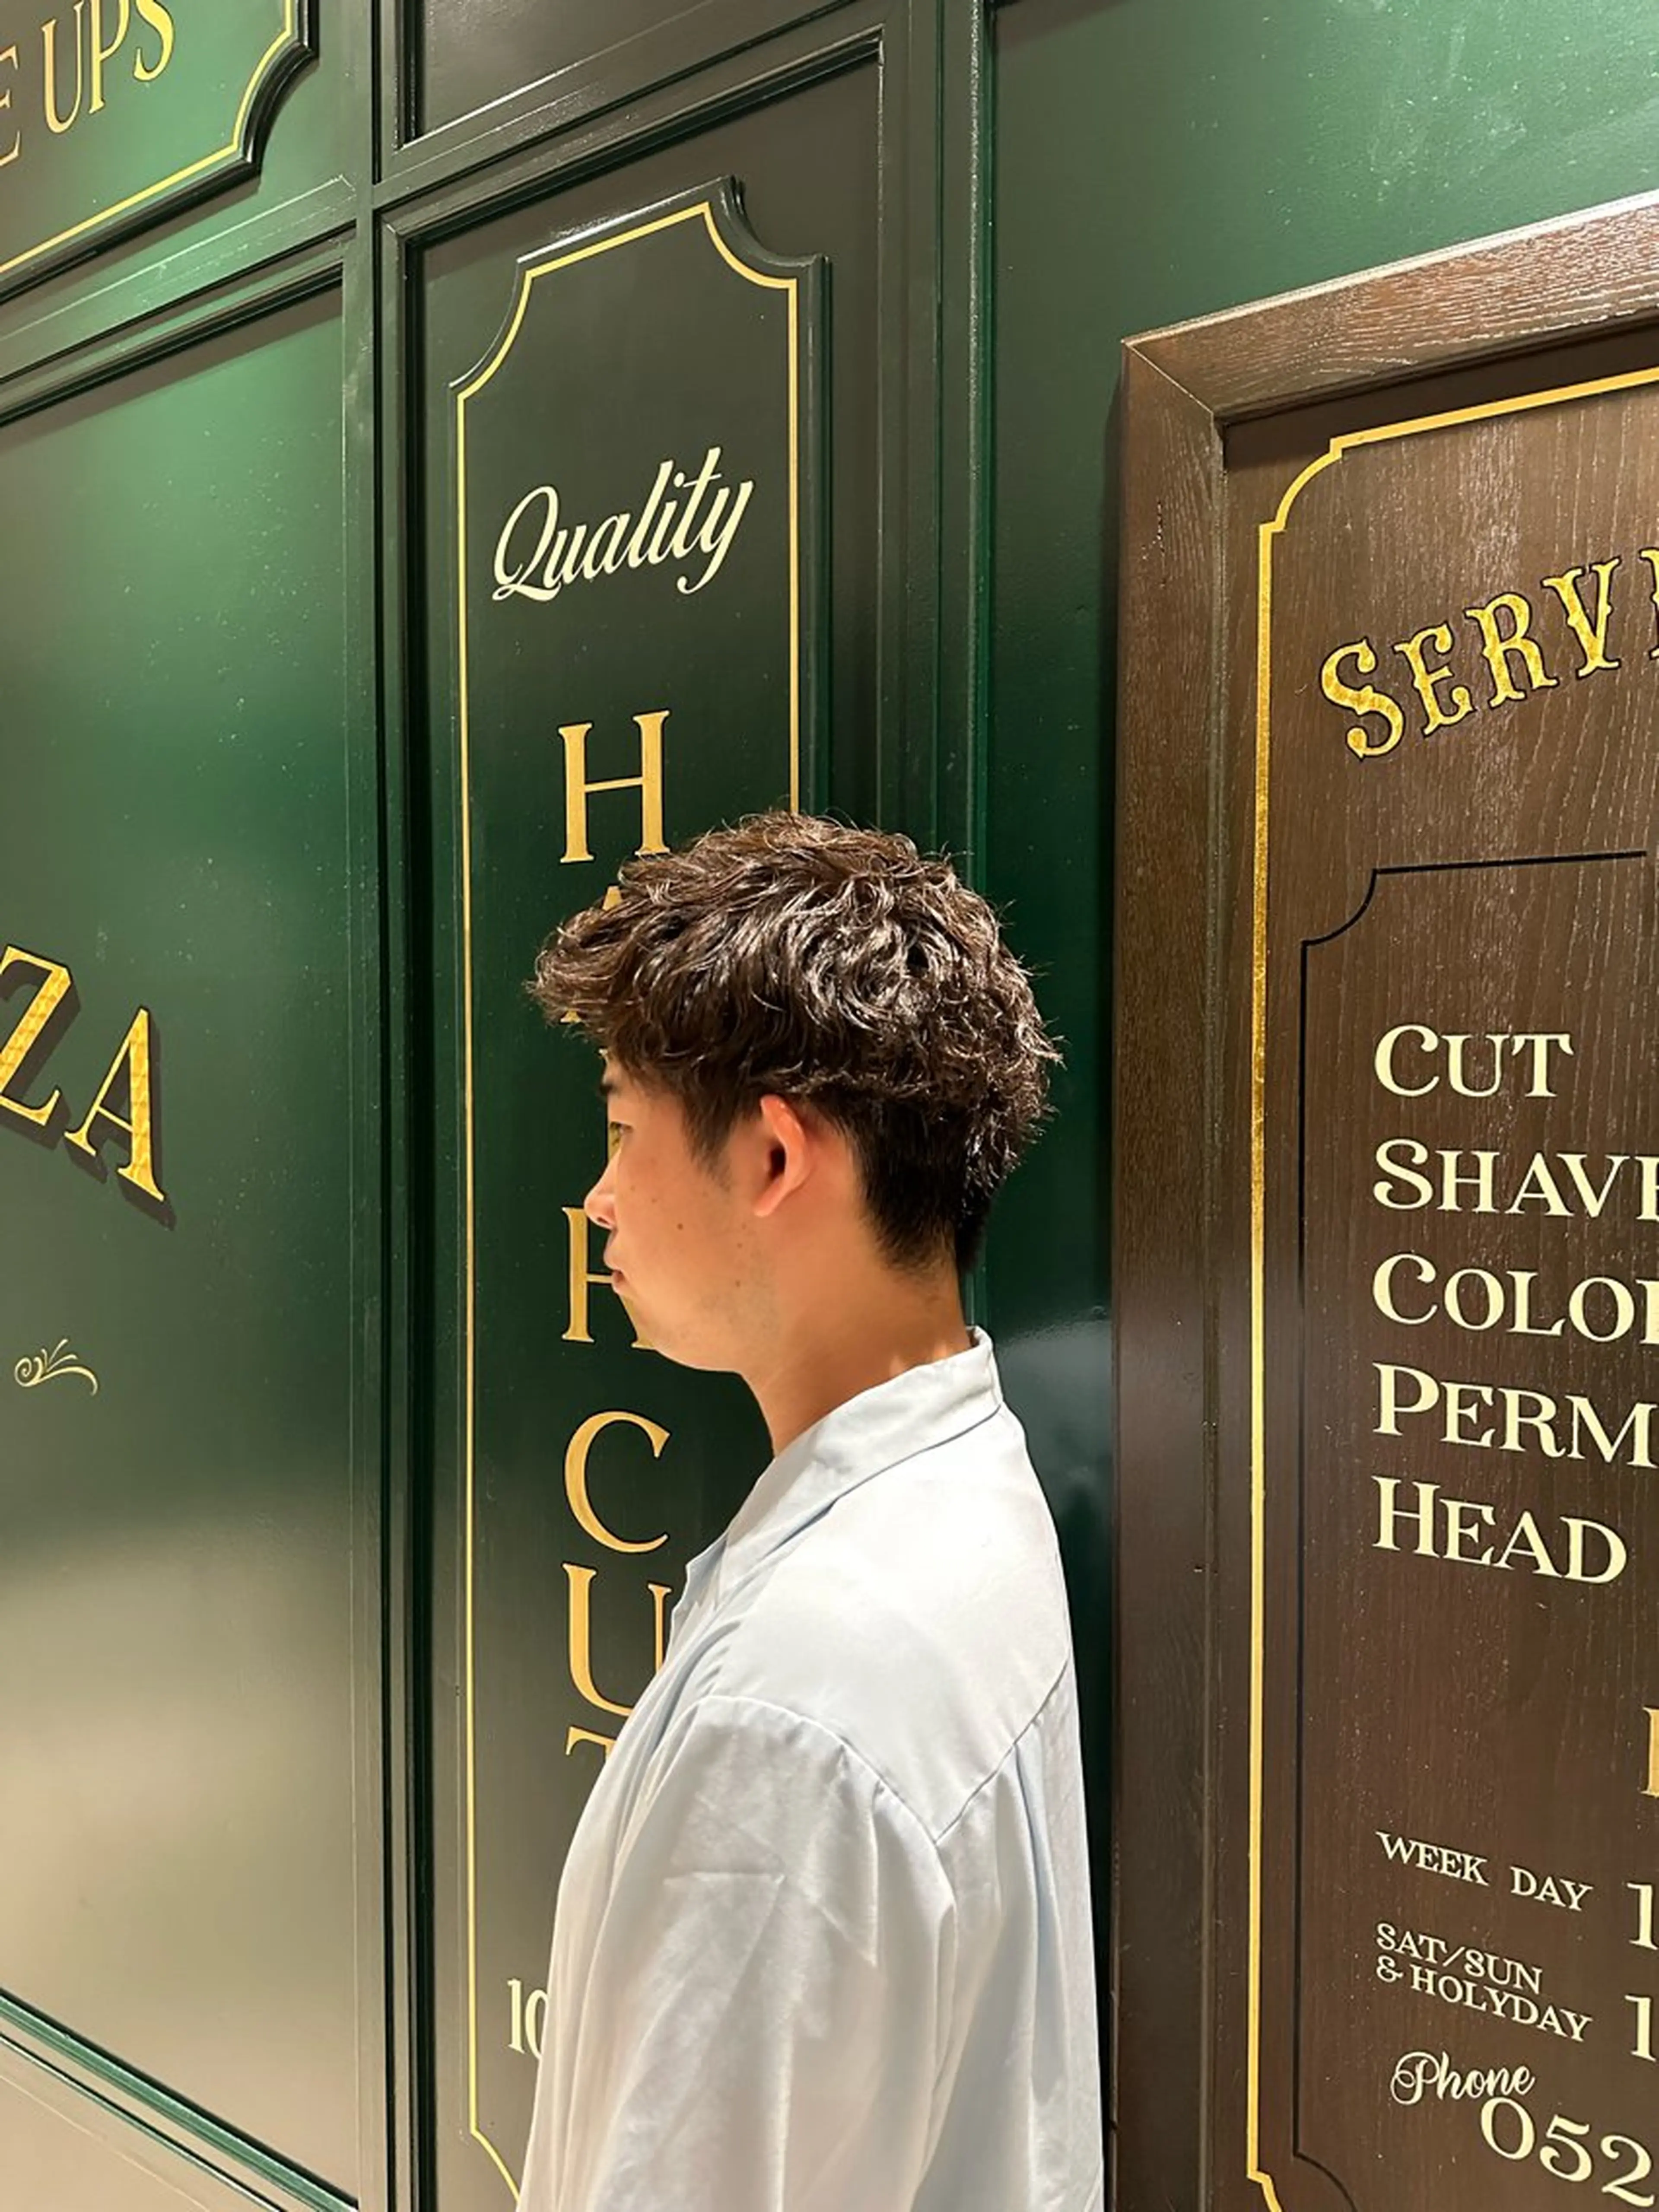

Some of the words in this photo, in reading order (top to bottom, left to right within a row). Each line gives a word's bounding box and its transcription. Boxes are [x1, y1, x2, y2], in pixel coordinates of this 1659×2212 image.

[41, 0, 174, 133] UPS
[492, 447, 753, 601] Quality
[1374, 1024, 1574, 1097] CUT
[1372, 1362, 1659, 1468] PERM
[1371, 1475, 1627, 1584] HEAD
[1376, 1831, 1490, 1886] WEEK
[1510, 1866, 1593, 1911] DAY
[1376, 1923, 1542, 1995] SAT/SUN
[1376, 1955, 1404, 1983] &
[1410, 1964, 1593, 2042] HOLYDAY
[1390, 2051, 1535, 2105] Phone
[1481, 2096, 1655, 2207] 052
